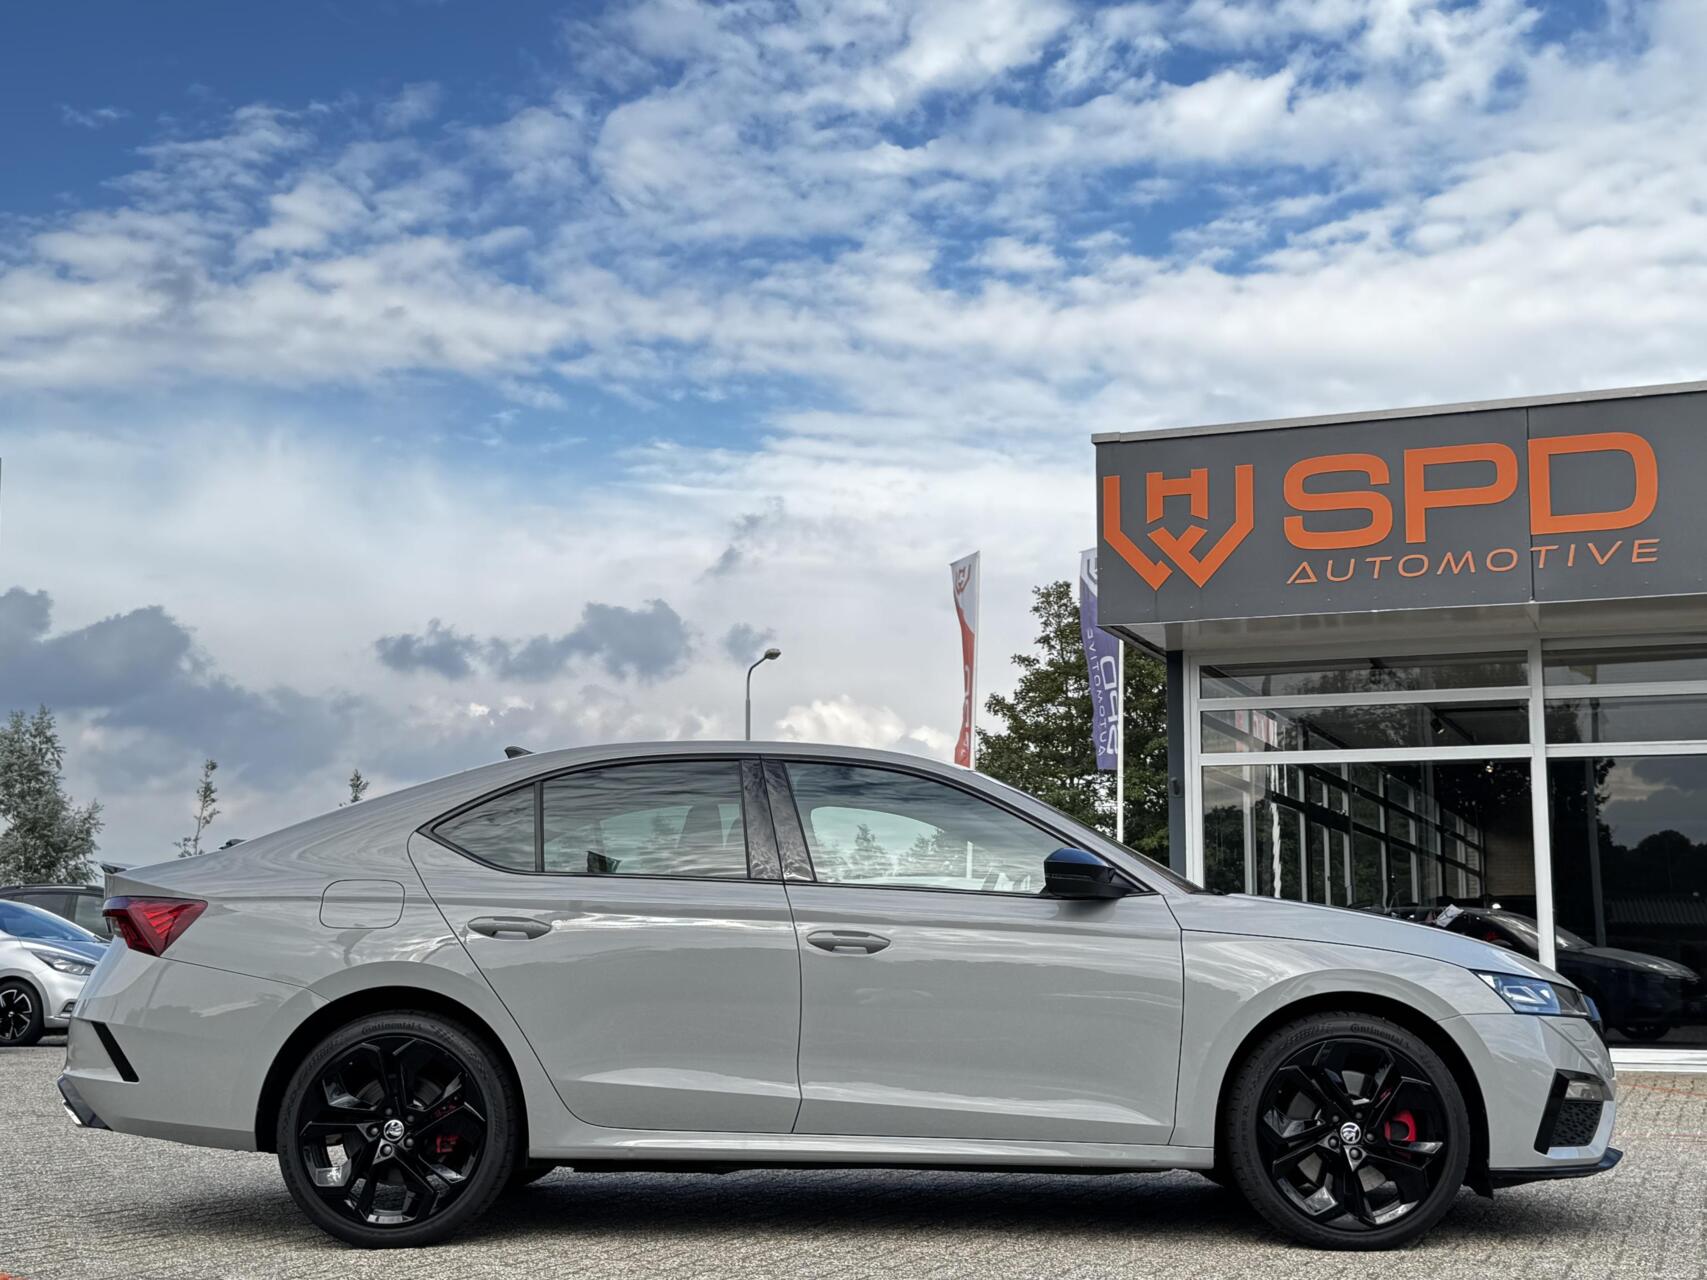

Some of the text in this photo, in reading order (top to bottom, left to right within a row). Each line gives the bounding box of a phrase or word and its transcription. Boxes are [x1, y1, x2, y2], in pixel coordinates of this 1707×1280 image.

[1283, 431, 1659, 550] SPD
[1286, 538, 1661, 585] AUTOMOTIVE
[1350, 1023, 1404, 1045] Continental
